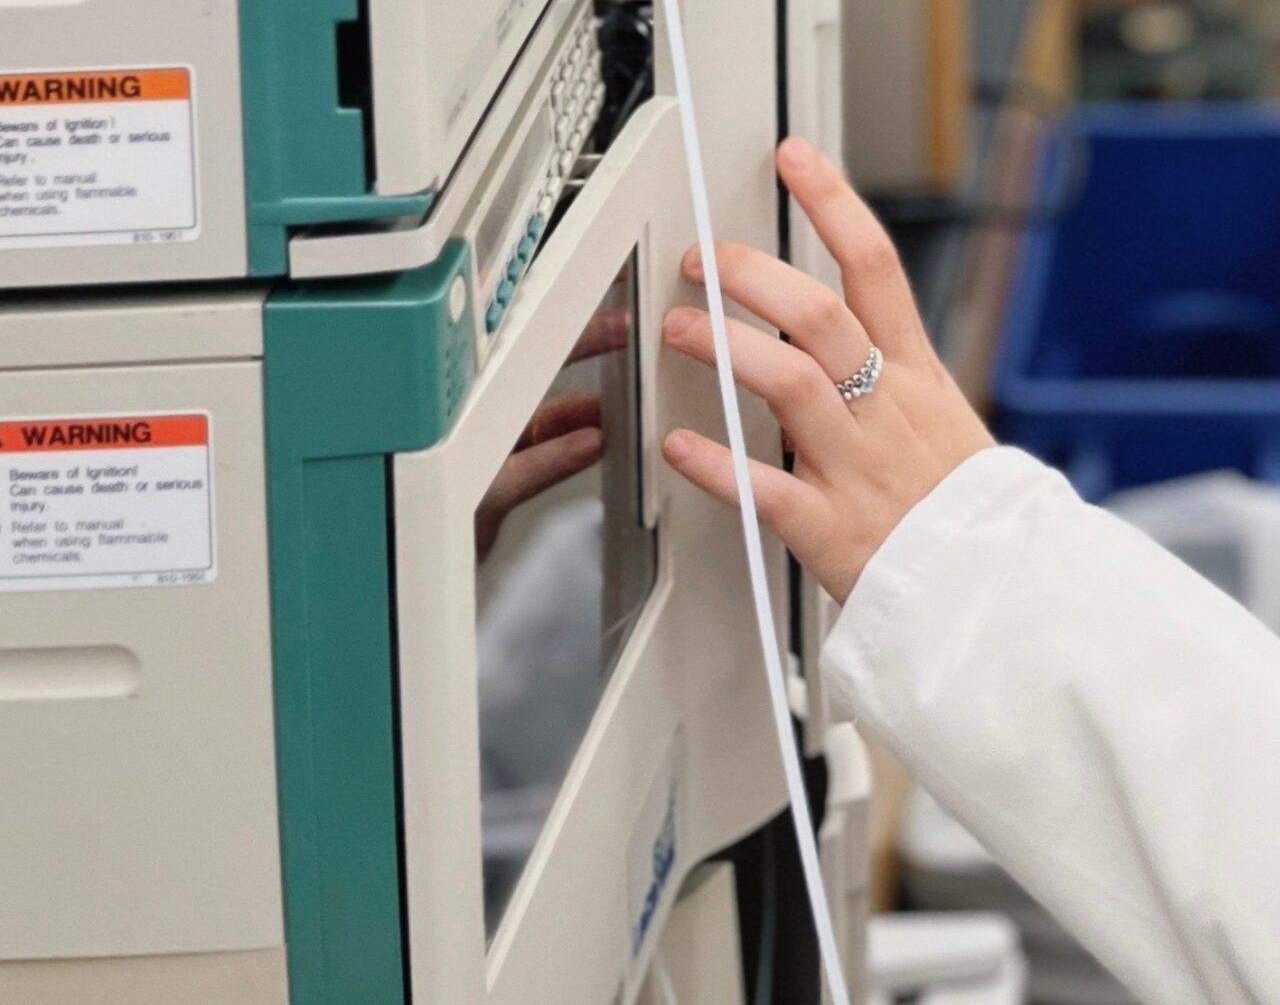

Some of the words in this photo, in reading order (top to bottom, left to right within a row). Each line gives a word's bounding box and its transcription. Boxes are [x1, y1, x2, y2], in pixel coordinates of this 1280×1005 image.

[0, 76, 141, 102] WARNING
[22, 422, 152, 446] WARNING
[9, 468, 60, 482] Beware
[66, 466, 79, 480] of
[9, 484, 37, 497] Can
[43, 483, 84, 496] cause
[91, 480, 128, 494] death
[135, 481, 148, 493] or
[155, 478, 203, 491] serious
[11, 520, 47, 533] Refer
[54, 520, 68, 533] to
[75, 518, 124, 531] manual
[12, 536, 47, 549] when
[55, 536, 91, 550] using
[98, 531, 168, 545] flammable
